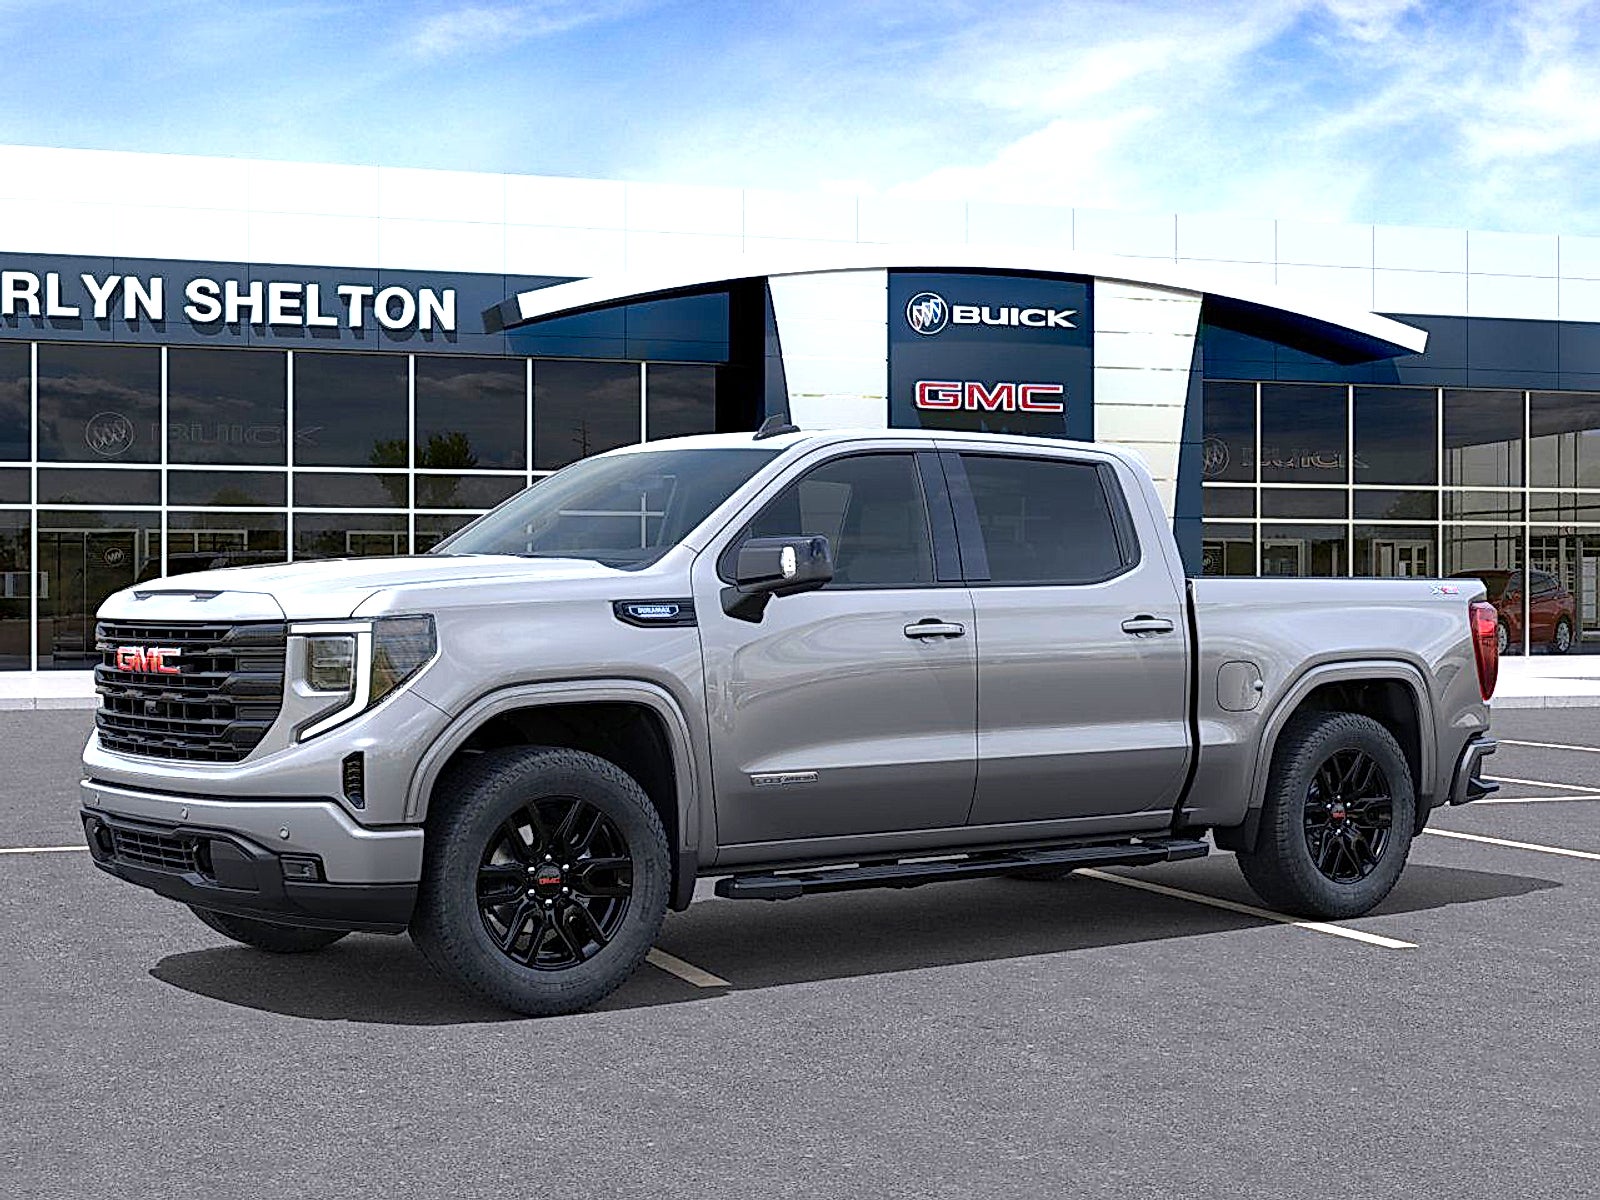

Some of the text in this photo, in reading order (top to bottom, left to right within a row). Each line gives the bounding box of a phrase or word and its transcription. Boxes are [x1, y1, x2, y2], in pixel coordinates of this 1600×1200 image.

[2, 271, 456, 330] RLYN SHELTON
[952, 305, 1077, 328] BUICK
[916, 381, 1063, 412] GMC
[116, 646, 182, 674] GMC
